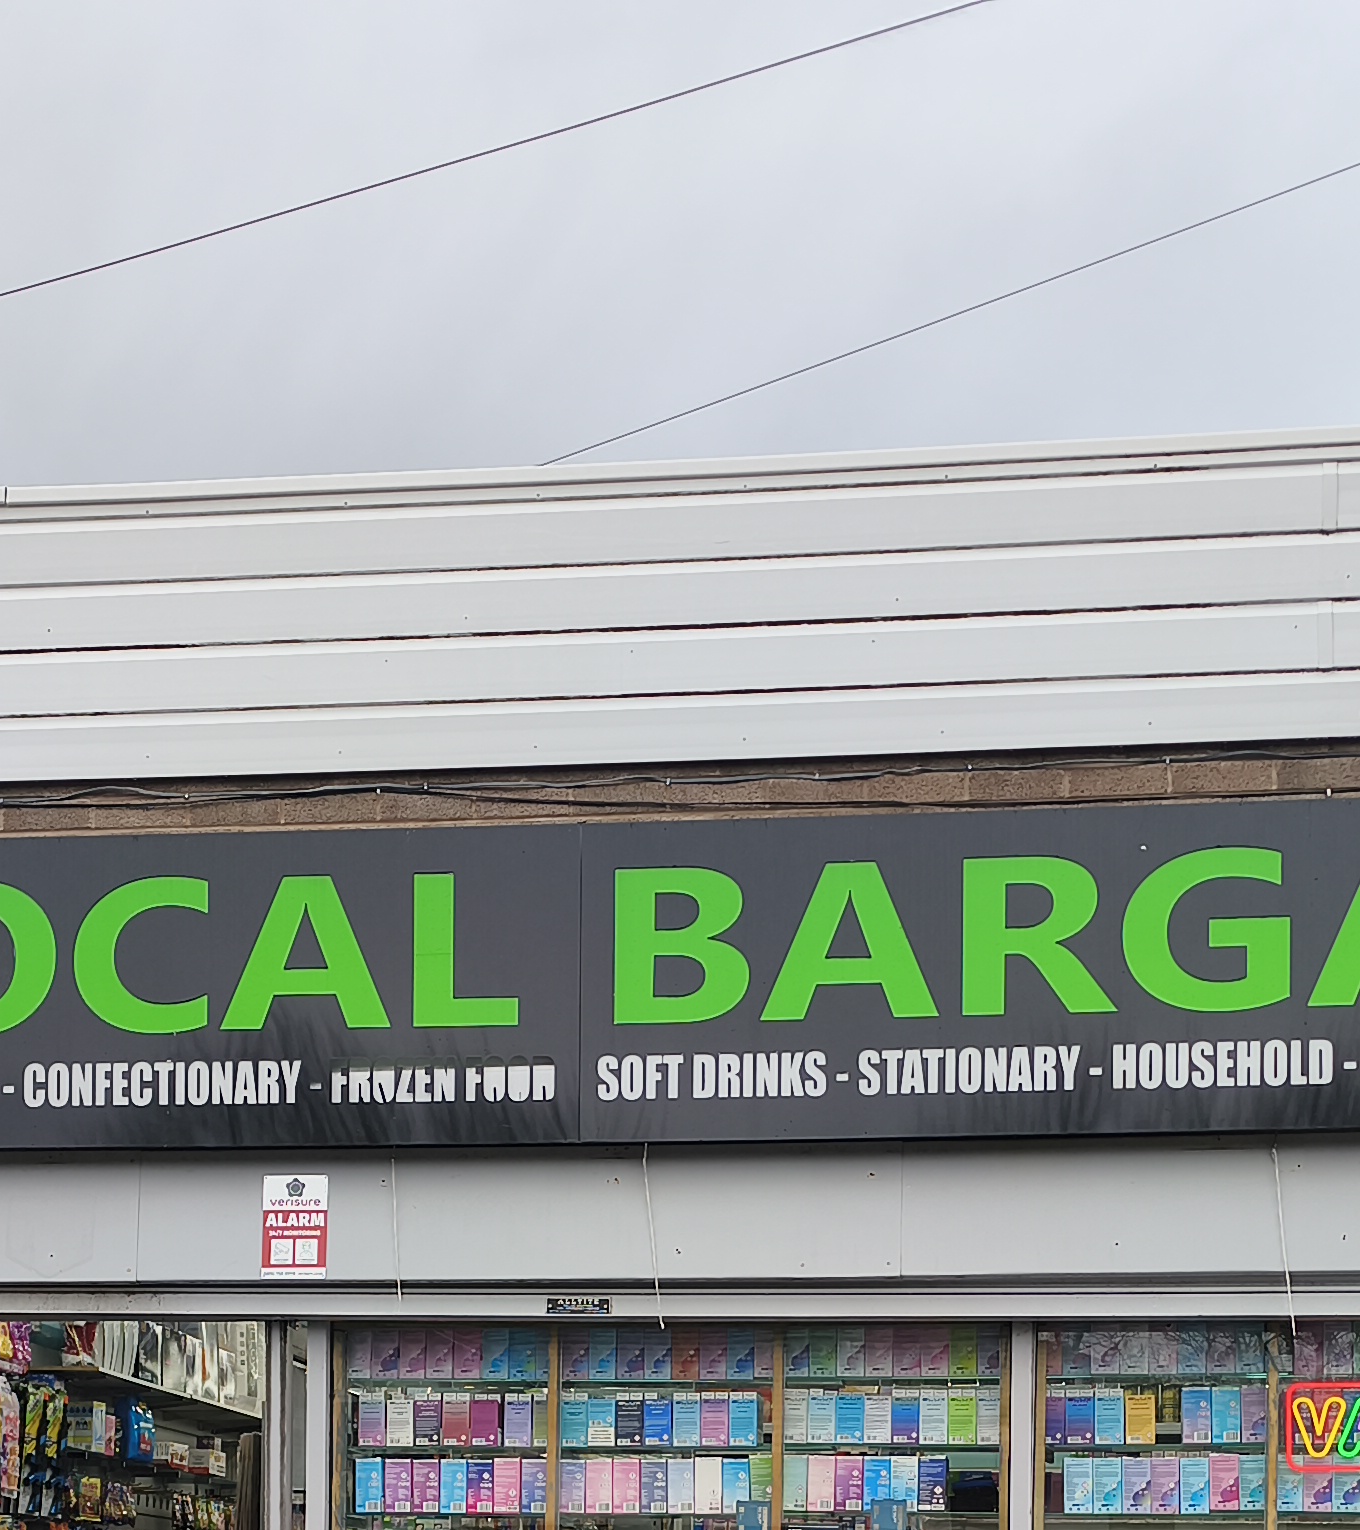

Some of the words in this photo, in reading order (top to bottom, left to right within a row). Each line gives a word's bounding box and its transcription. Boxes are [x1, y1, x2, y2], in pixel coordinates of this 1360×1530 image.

[23, 1060, 301, 1108] CONFECTIONARY
[596, 1054, 685, 1103] SOFT
[691, 1052, 828, 1101] DRINKS
[858, 1045, 1080, 1096] STATIONARY
[1112, 1039, 1333, 1091] HOUSEHOLD
[269, 1198, 321, 1206] verisure
[265, 1212, 325, 1227] ALARM
